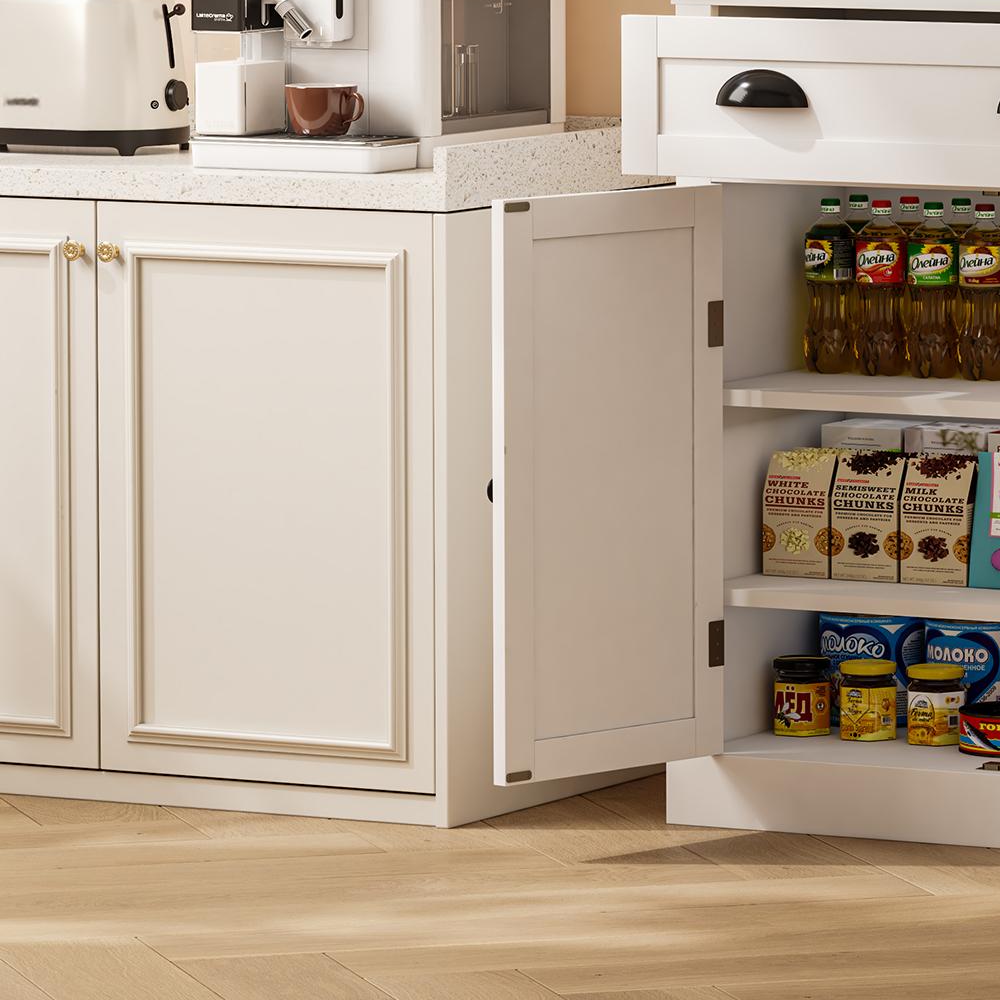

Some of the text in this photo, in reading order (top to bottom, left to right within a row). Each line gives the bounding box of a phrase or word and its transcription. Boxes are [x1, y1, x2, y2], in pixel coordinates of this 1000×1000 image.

[860, 253, 895, 268] Олейна
[912, 257, 948, 270] Олейна
[960, 257, 993, 270] Олейна
[768, 480, 809, 488] WHITE
[835, 484, 896, 493] SEMISWEET
[766, 488, 826, 496] CHOCOLATE
[834, 492, 895, 500] CHOCOLATE
[904, 488, 938, 496] MILK
[765, 495, 825, 506] CHUNKS
[833, 499, 894, 510] CHUNKS
[903, 496, 965, 504] CHOCOLATE
[903, 502, 964, 514] CHUNKS
[927, 644, 989, 663] МОЛОКО
